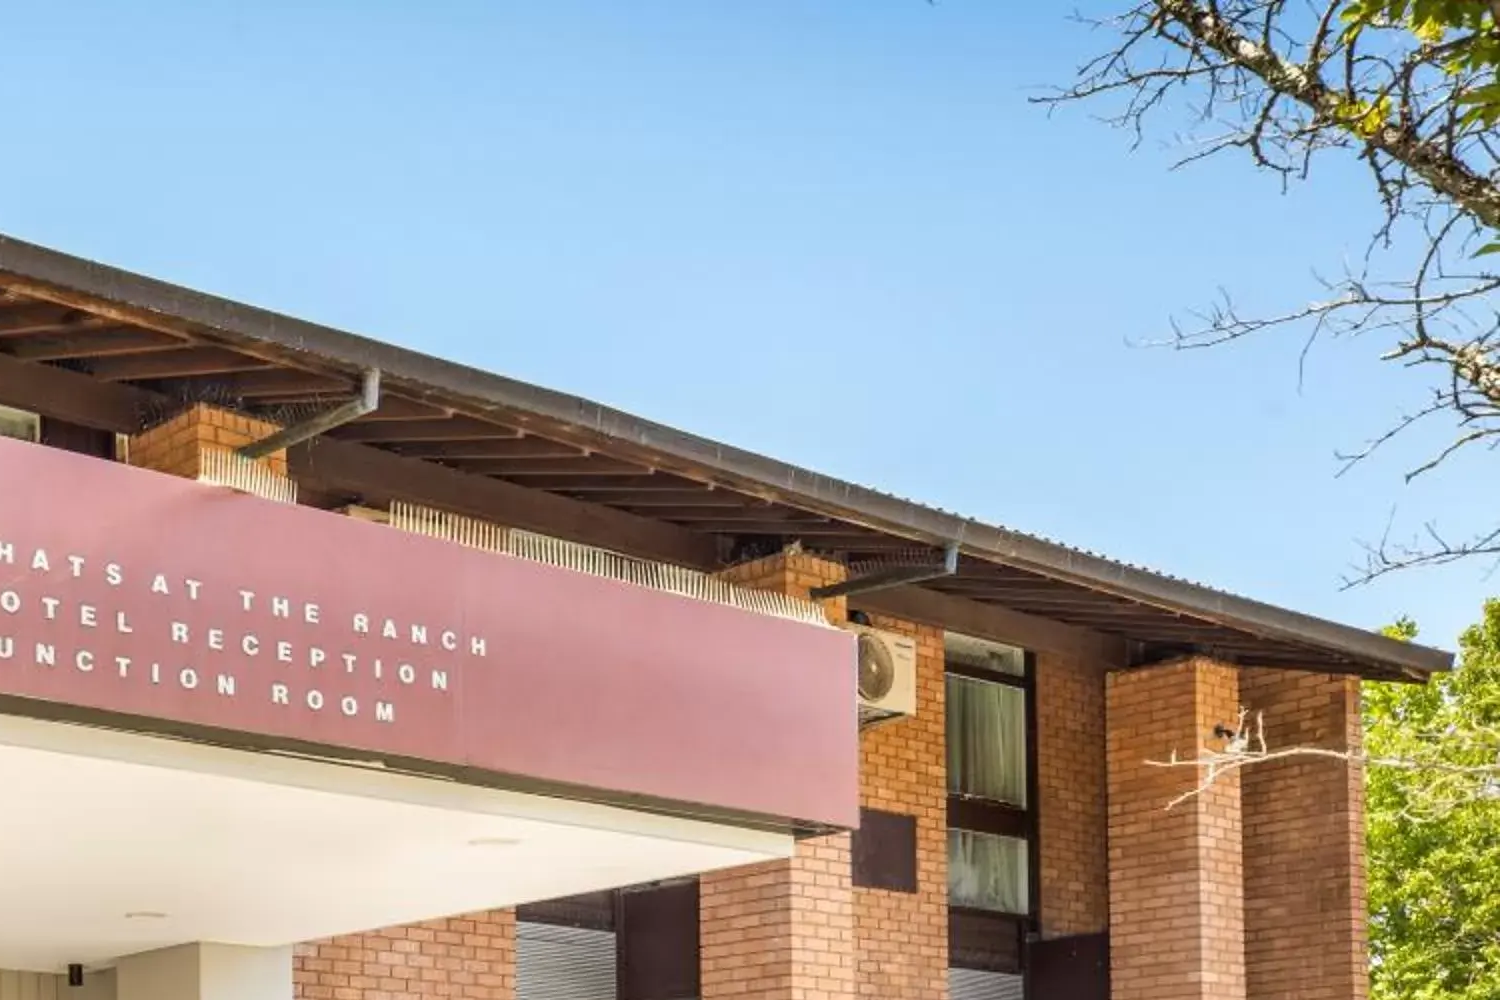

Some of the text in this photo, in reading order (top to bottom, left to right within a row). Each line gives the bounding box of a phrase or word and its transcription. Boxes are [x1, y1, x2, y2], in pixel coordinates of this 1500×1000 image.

[151, 574, 202, 600] AT
[239, 590, 320, 624] THE
[353, 613, 486, 657] RANCH
[171, 621, 447, 690] RECEPTION
[272, 684, 395, 722] ROOM
